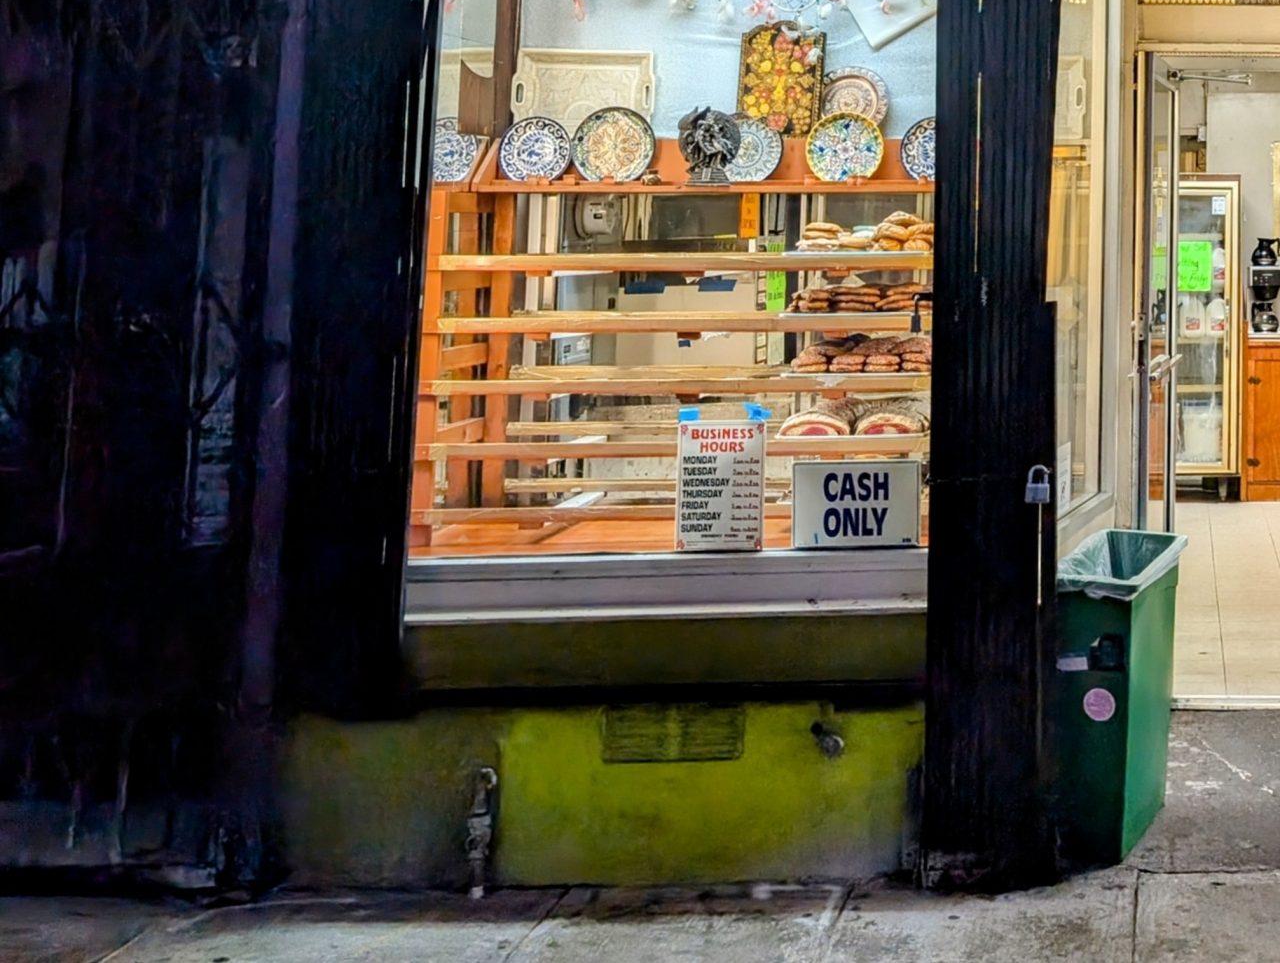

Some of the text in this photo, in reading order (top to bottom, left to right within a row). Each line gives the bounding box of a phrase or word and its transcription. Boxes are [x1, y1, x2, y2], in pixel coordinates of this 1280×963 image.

[691, 428, 754, 439] BUSINESS
[700, 441, 744, 453] HOURS
[683, 456, 717, 465] MONDAY
[683, 467, 717, 476] TUESDAY
[682, 478, 730, 487] WEDNESDAY
[823, 472, 889, 502] CASH
[682, 489, 723, 498] THURSDAY
[681, 501, 709, 510] FRIDAY
[681, 512, 722, 521] SATURDAY
[823, 507, 888, 537] ONLY
[680, 524, 713, 533] SUNDAY
